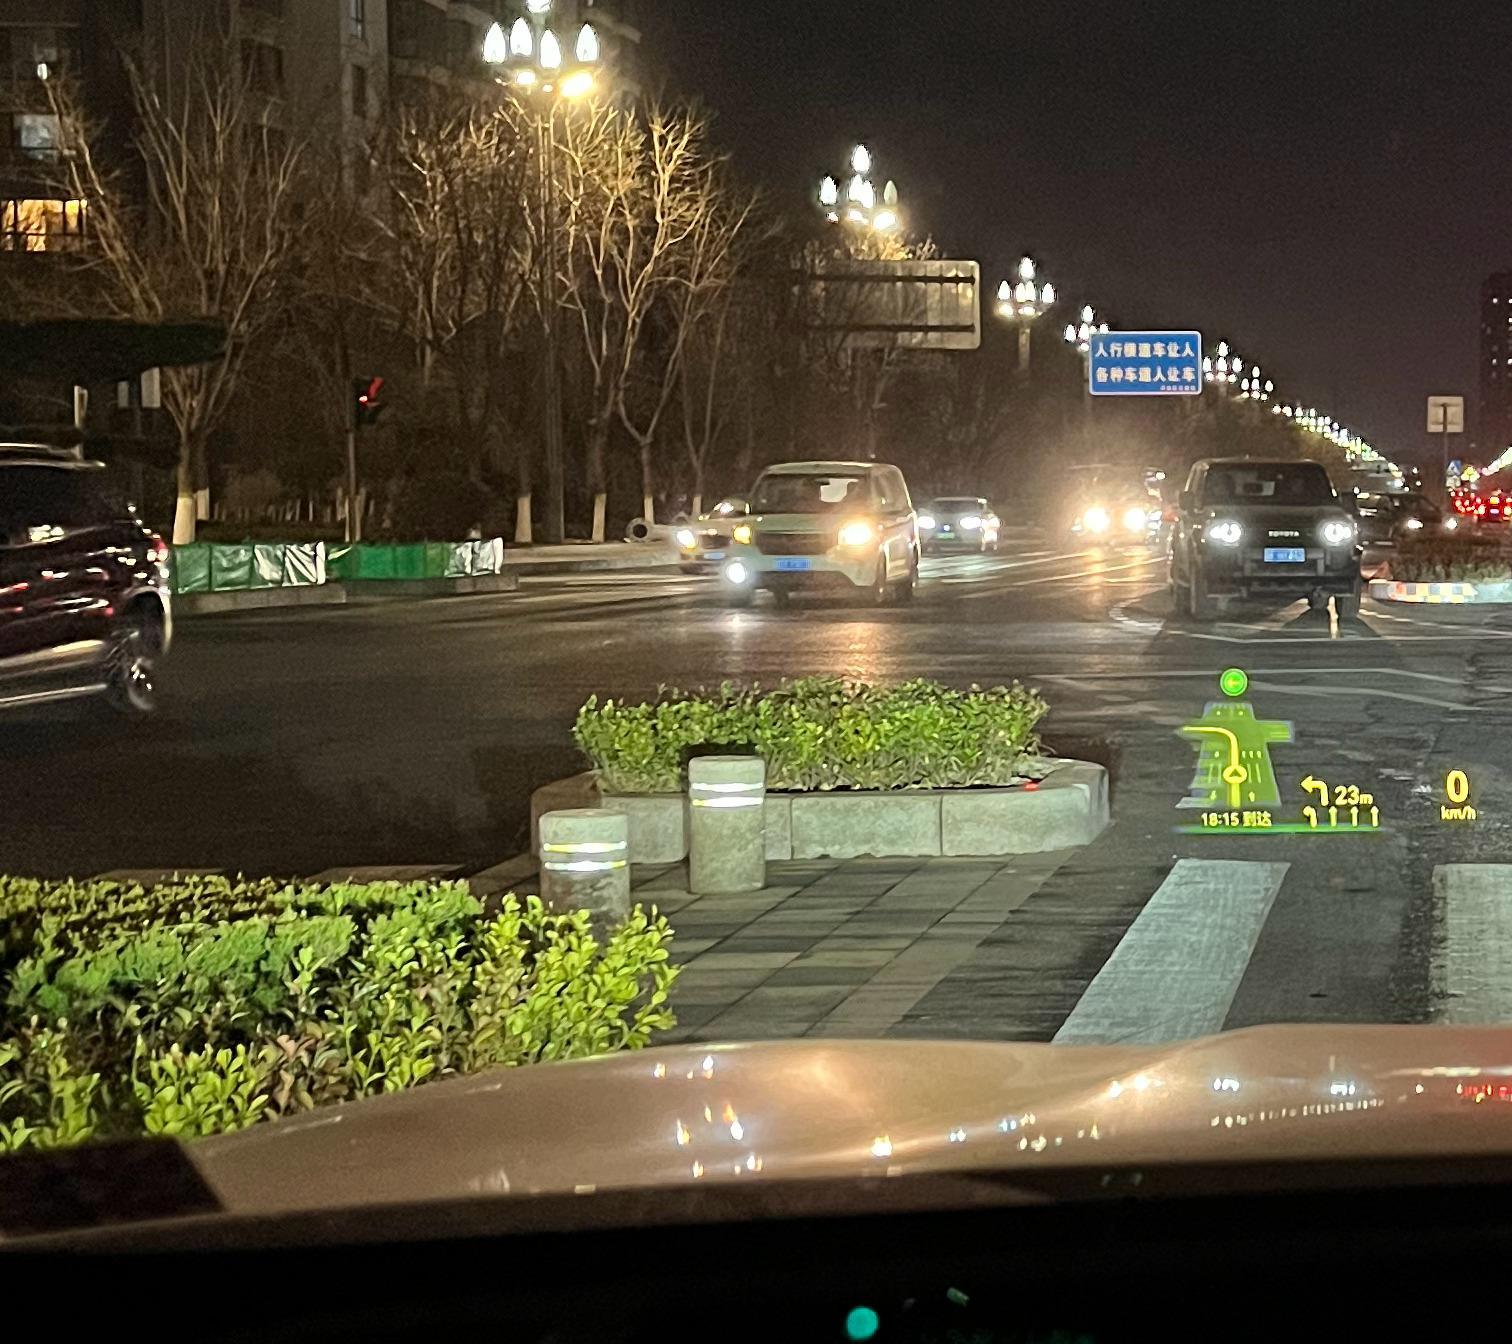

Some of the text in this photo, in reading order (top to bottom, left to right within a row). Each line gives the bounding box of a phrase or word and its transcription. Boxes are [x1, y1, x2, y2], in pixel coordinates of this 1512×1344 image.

[1333, 784, 1374, 807] 23m
[1445, 769, 1470, 804] 0
[1200, 811, 1240, 828] 18:15
[1440, 804, 1478, 822] km/h
